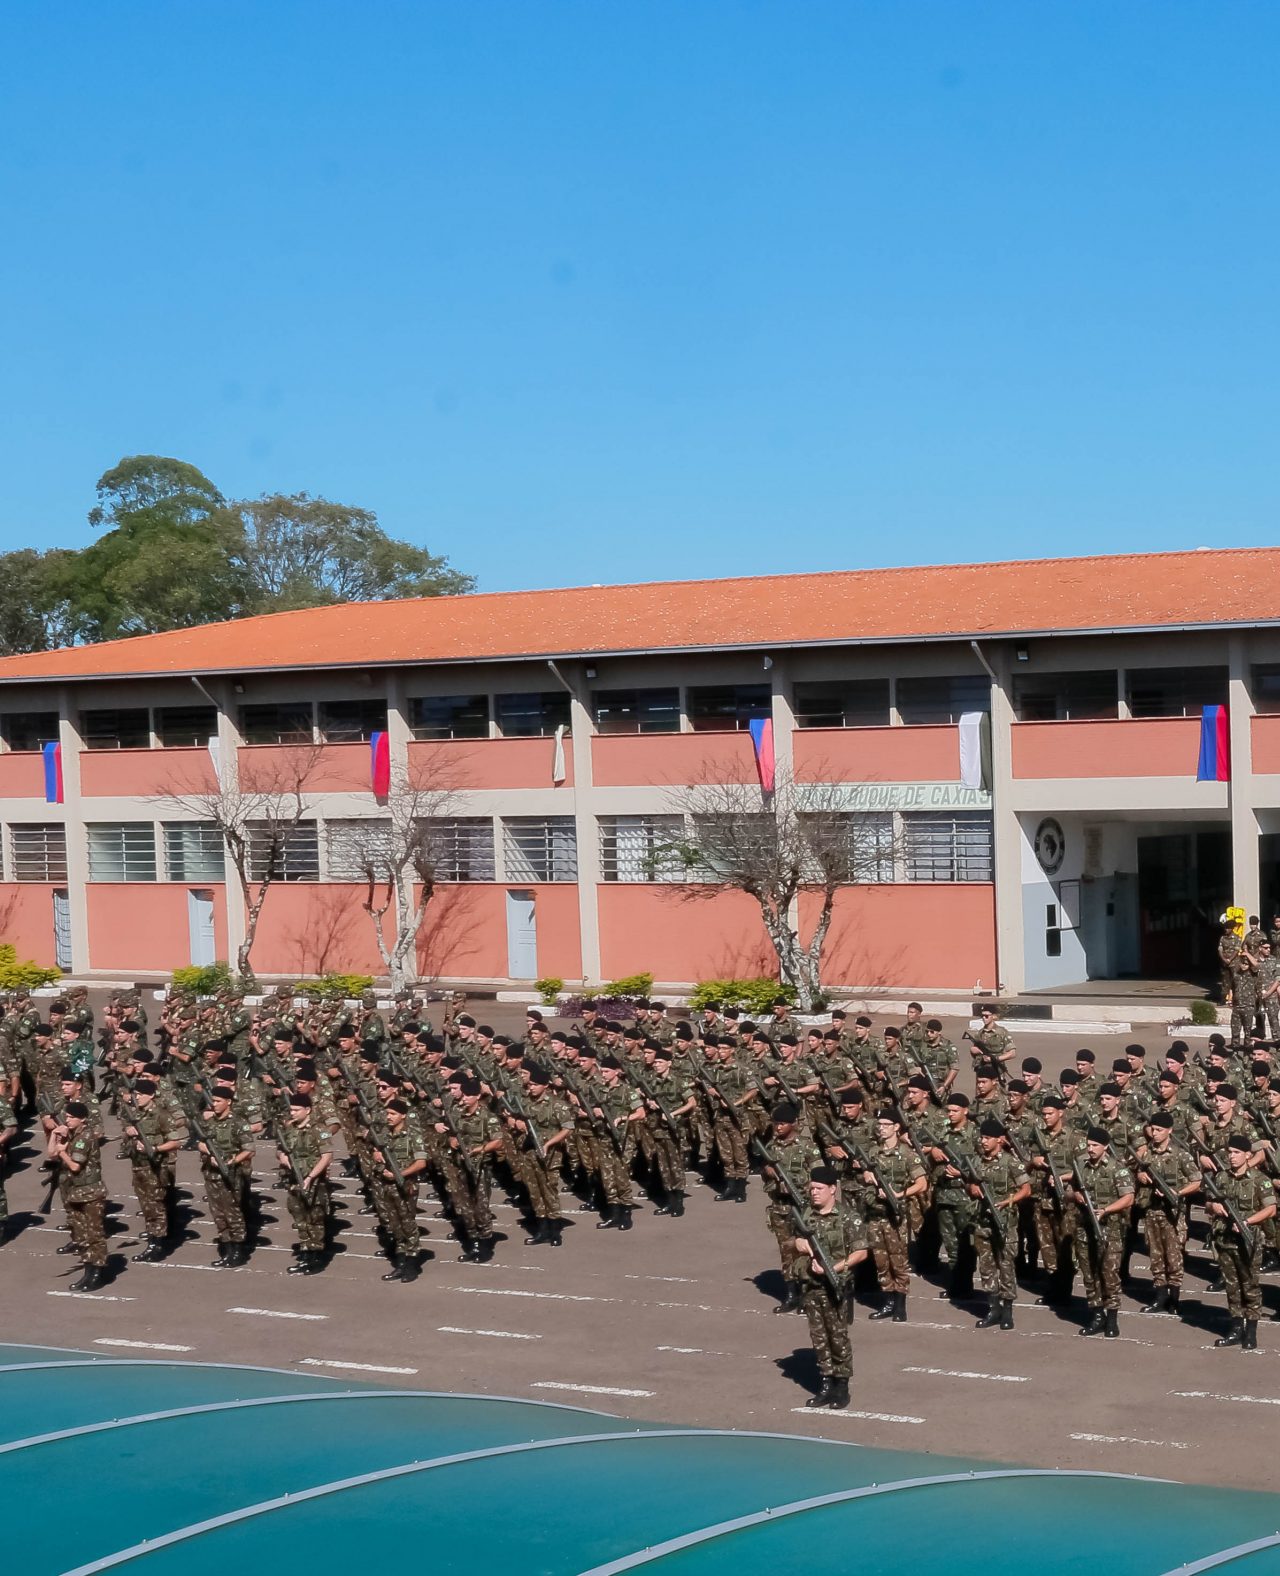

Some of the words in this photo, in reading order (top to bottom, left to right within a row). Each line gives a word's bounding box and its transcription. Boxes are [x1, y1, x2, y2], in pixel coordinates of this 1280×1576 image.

[848, 787, 900, 806] DUQUE
[904, 786, 926, 806] DE
[930, 785, 990, 805] CAXIAS
